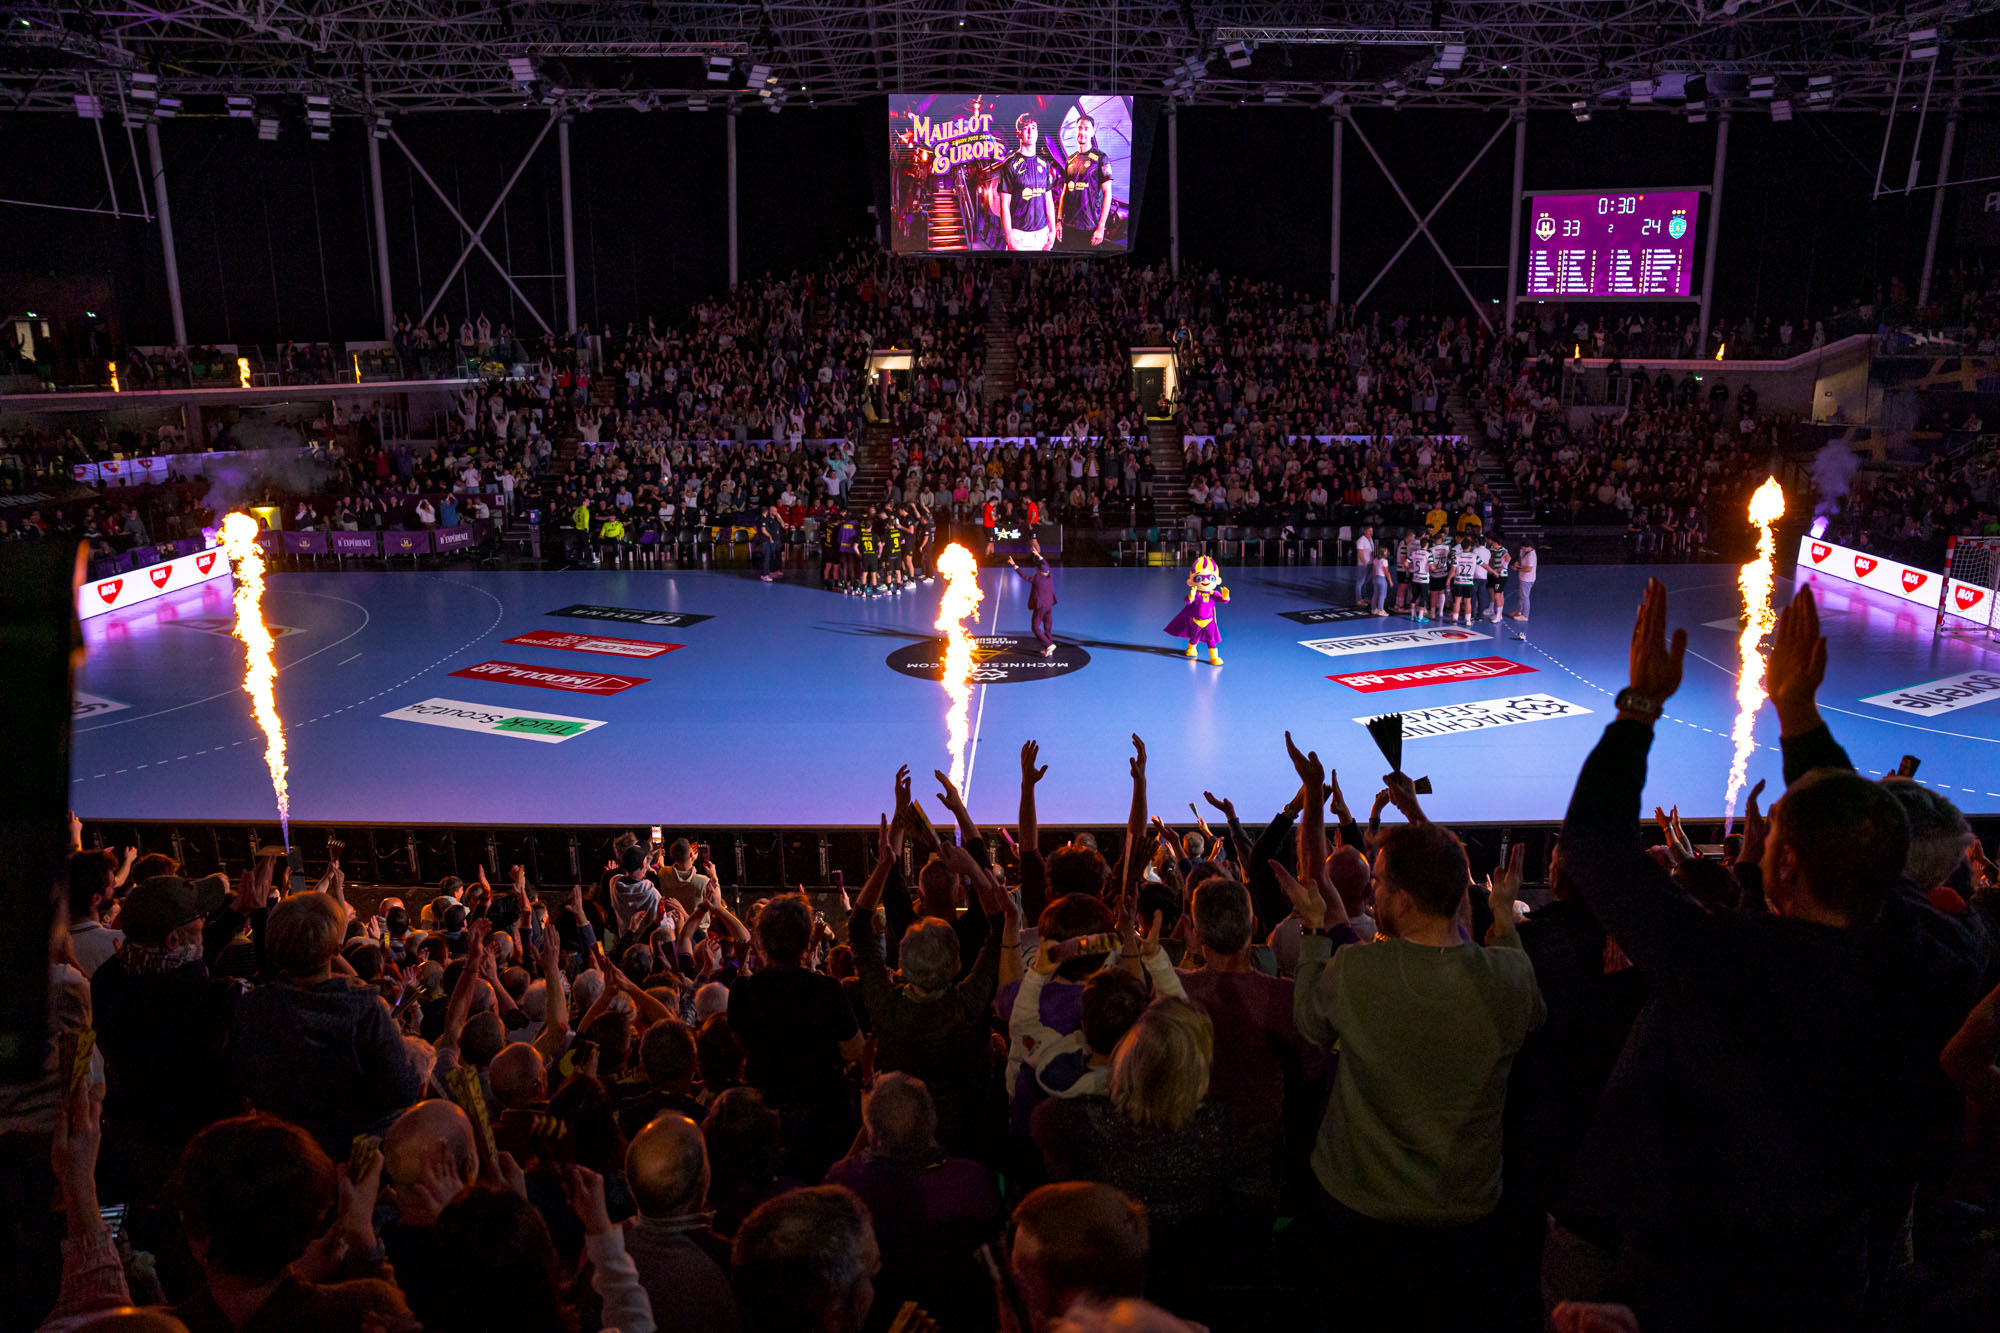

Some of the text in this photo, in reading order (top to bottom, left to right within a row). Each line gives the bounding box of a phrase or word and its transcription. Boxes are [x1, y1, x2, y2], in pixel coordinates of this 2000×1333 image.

[908, 112, 993, 147] MAILLOT
[933, 141, 1006, 174] EUROPE
[1598, 197, 1636, 214] 0:30
[1562, 220, 1581, 237] 33
[1608, 224, 1614, 233] 2
[1641, 218, 1662, 235] 24
[1812, 544, 1825, 557] MOL
[1855, 558, 1870, 570] MOL
[1903, 572, 1919, 585] MOL
[1956, 587, 1974, 602] MOL
[1315, 631, 1434, 650] Ventelis
[470, 665, 592, 686] MODULAR
[1348, 664, 1474, 687] MODULAR
